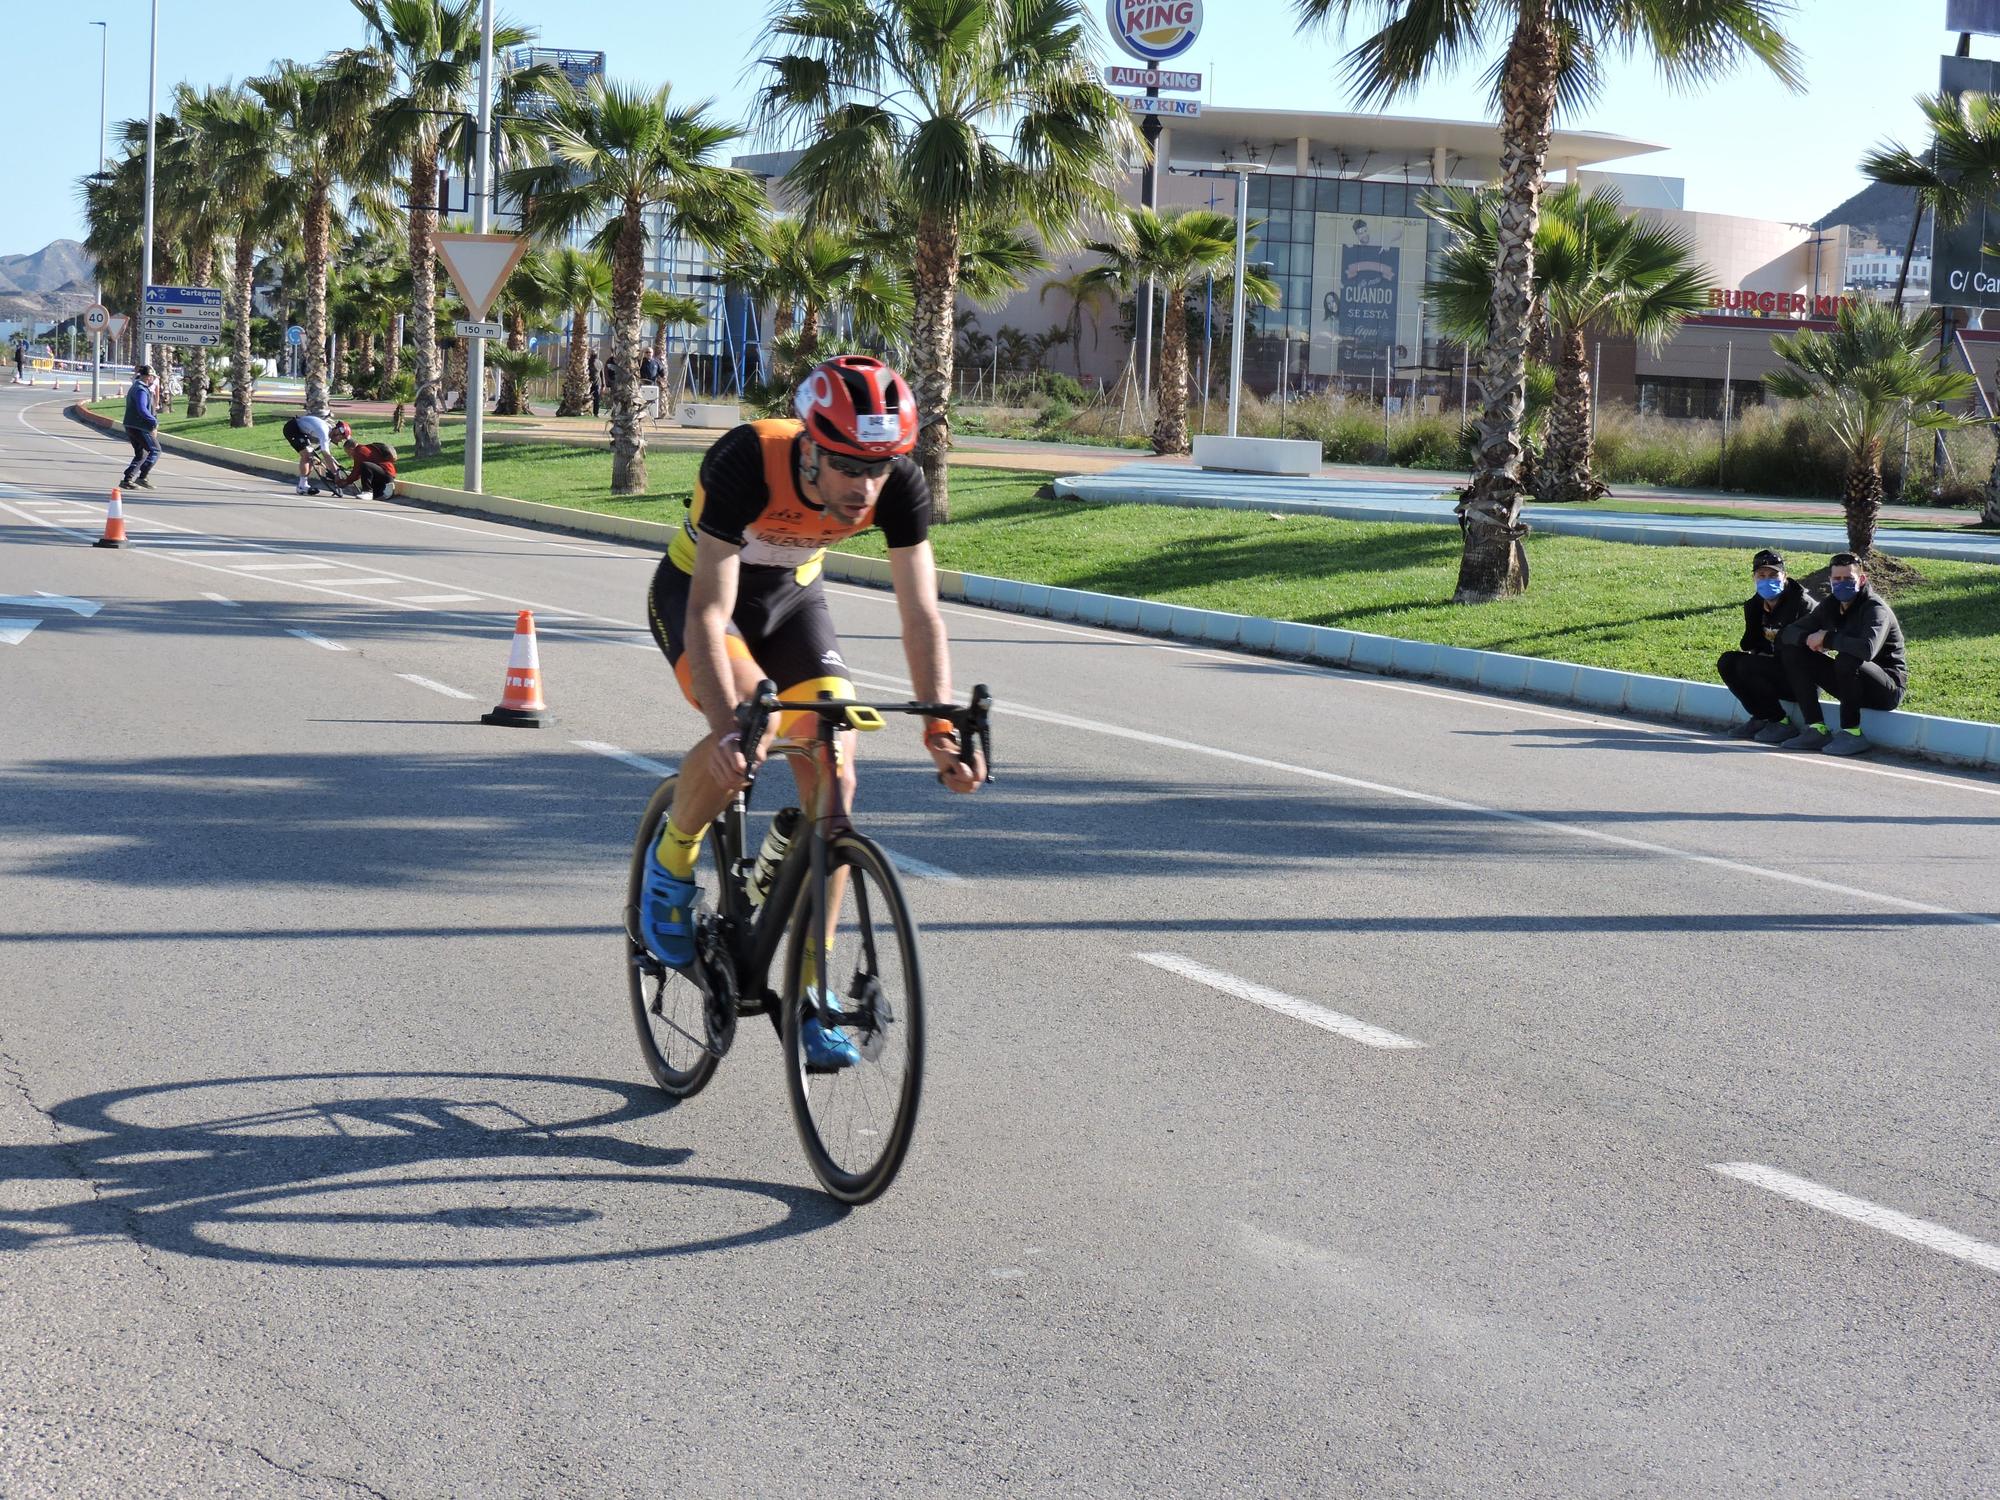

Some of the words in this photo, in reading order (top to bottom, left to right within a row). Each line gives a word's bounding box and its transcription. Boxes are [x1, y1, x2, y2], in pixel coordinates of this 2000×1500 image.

[1126, 2, 1193, 34] KING
[1116, 68, 1156, 85] AUTO
[1159, 72, 1198, 88] KING
[1157, 101, 1198, 114] KING
[1950, 270, 1969, 292] C/
[180, 289, 220, 298] Cartagena
[1345, 286, 1393, 304] CUANDO
[1709, 288, 1806, 314] BURGER
[89, 313, 104, 323] 40
[198, 309, 220, 317] Lorca
[1347, 308, 1360, 318] SE
[172, 322, 219, 331] Calabardina
[464, 326, 480, 334] 150
[158, 333, 189, 343] Hornillo
